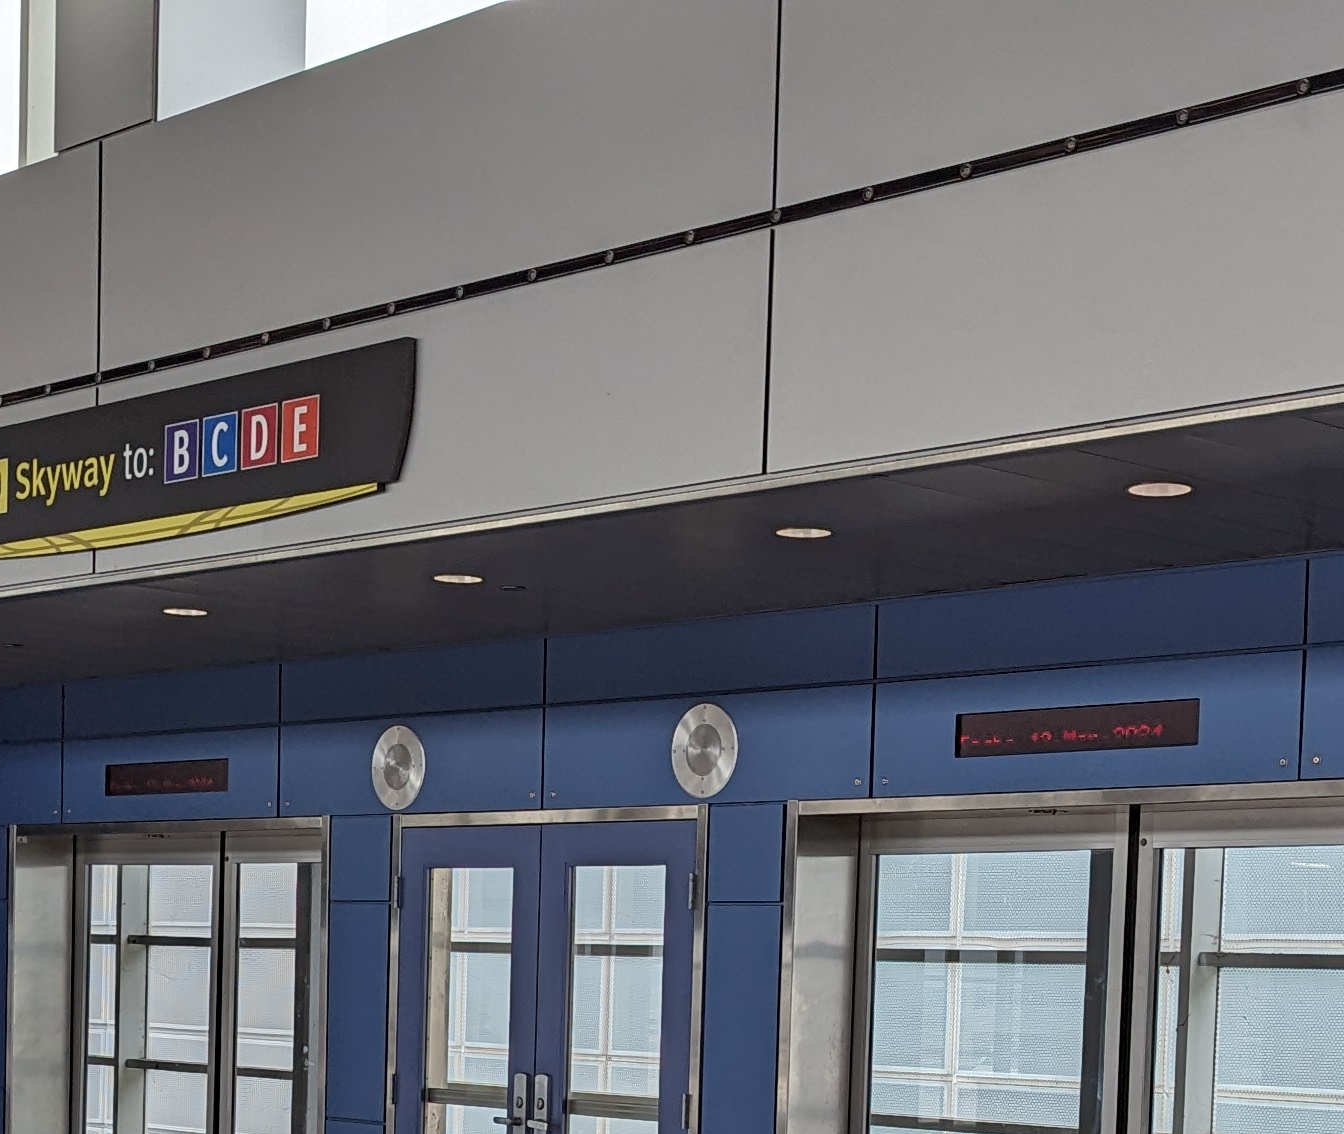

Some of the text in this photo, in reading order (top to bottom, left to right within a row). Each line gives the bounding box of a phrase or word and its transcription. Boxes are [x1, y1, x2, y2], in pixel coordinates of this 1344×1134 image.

[15, 406, 308, 507] Skyway to: B C D E
